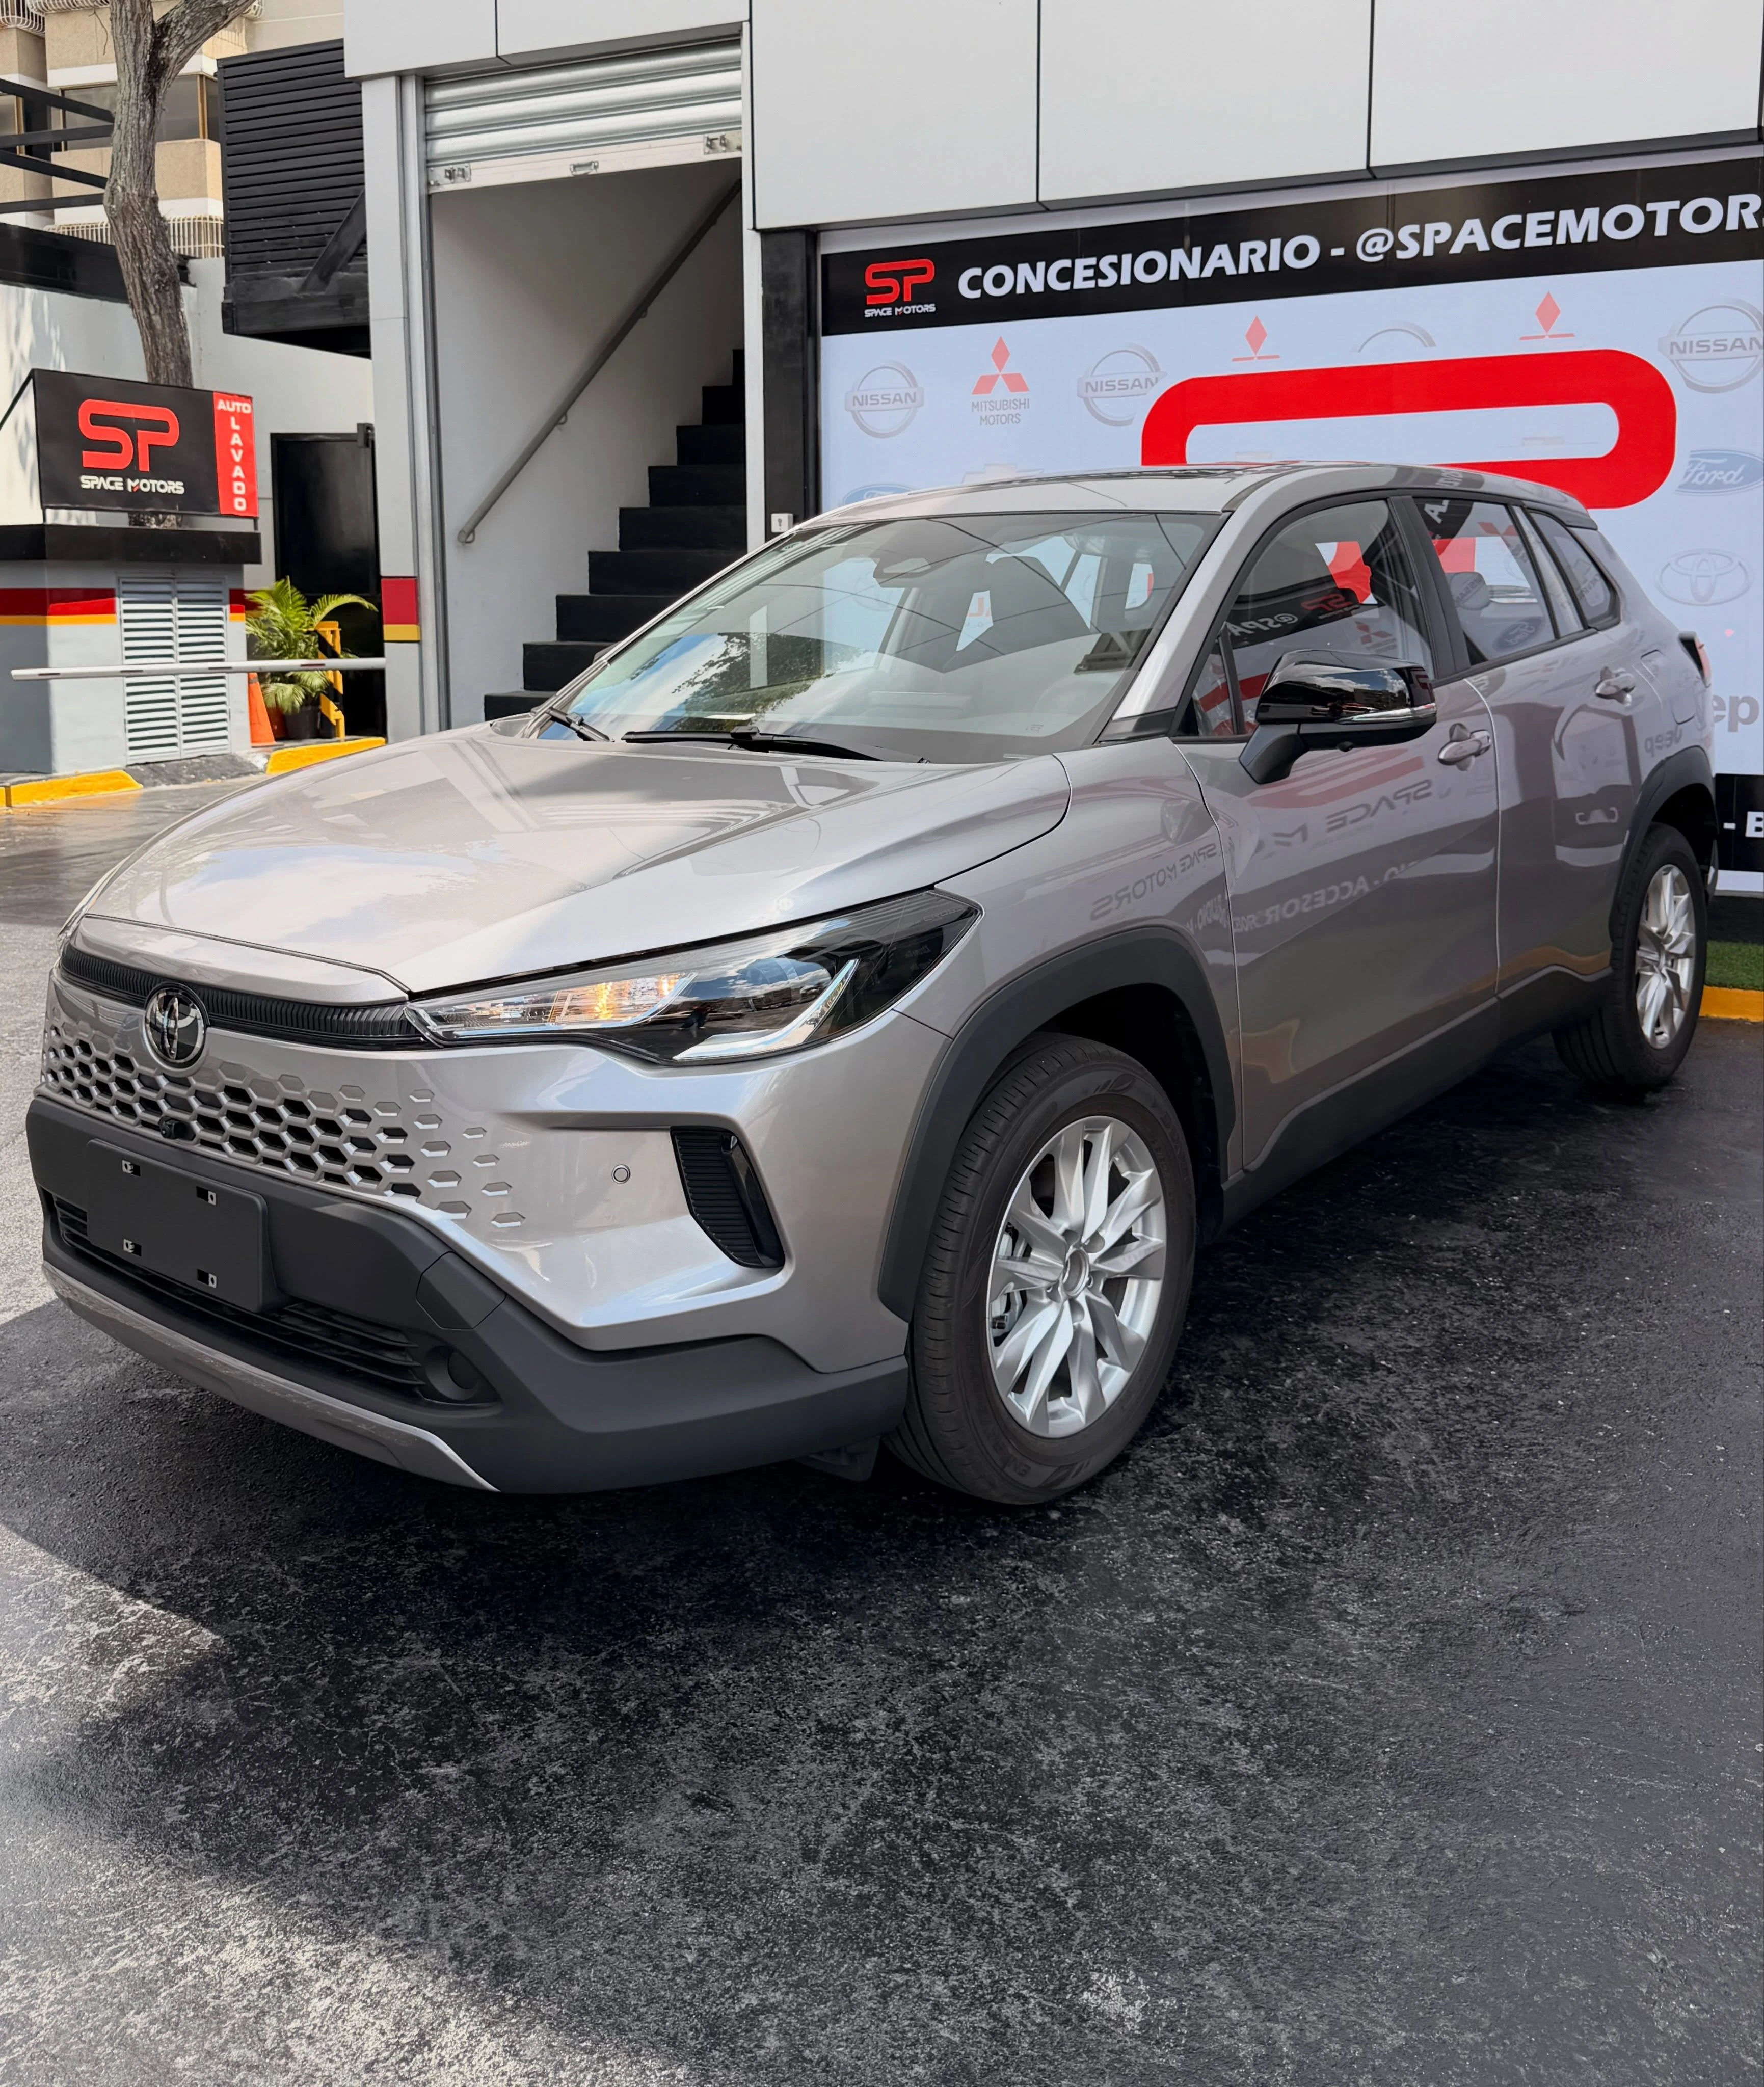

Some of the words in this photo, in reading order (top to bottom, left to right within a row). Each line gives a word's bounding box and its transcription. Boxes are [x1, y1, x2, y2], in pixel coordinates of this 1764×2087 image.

[958, 234, 1320, 299] CONCESIONARIO
[1356, 193, 1764, 262] @SPACEMOTOR
[864, 259, 935, 305] SP
[864, 307, 892, 317] SPACE
[894, 304, 936, 316] MOTORS
[1670, 336, 1764, 355] NISSAN
[1085, 376, 1158, 394] NISSAN
[217, 399, 252, 413] AUTO
[852, 392, 917, 407] NISSAN
[971, 398, 1030, 412] MITSUBISHI
[980, 413, 1021, 426] MOTORS
[77, 399, 180, 472] SP
[230, 416, 247, 511] LAVADO
[1682, 458, 1747, 486] Ford
[79, 475, 124, 491] SPACE
[126, 478, 185, 494] MOTORS
